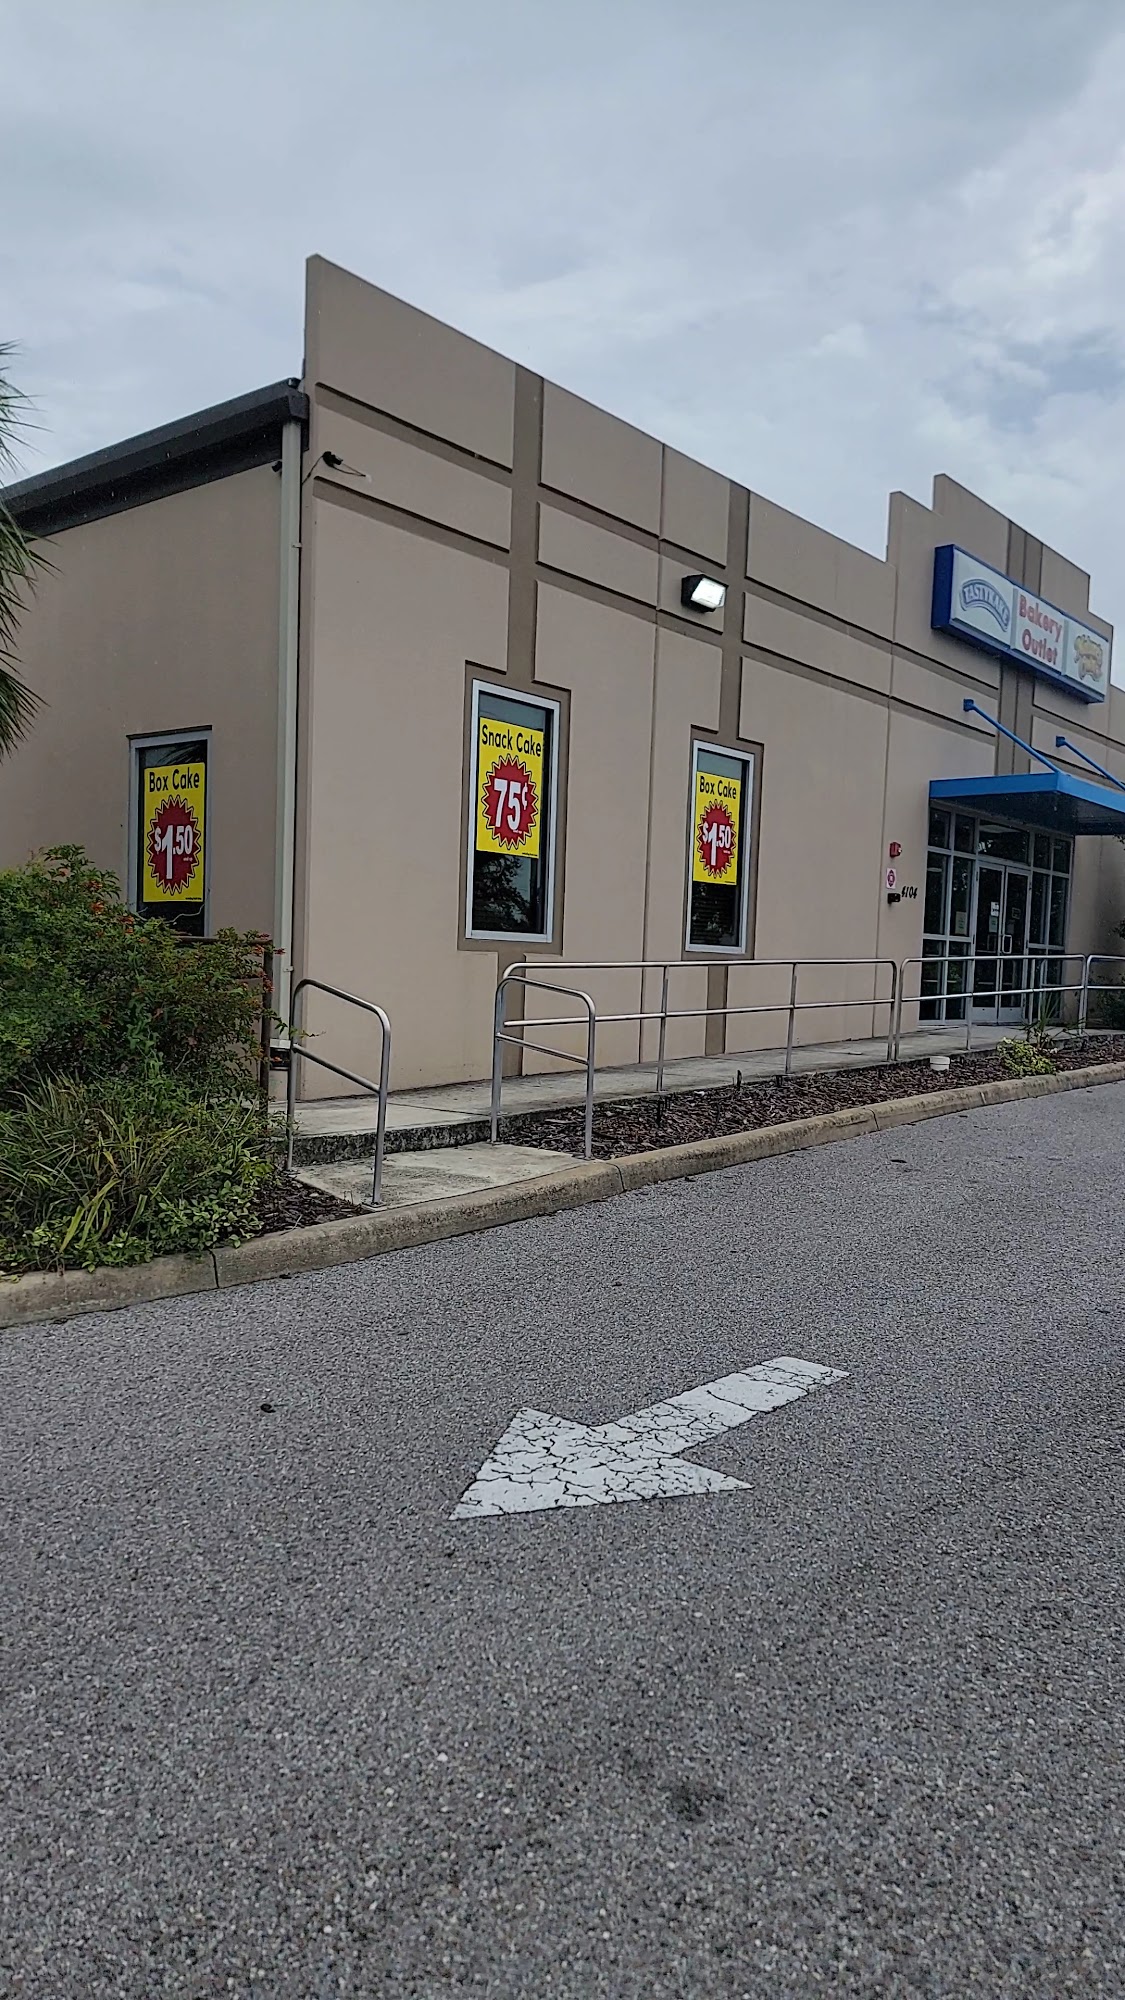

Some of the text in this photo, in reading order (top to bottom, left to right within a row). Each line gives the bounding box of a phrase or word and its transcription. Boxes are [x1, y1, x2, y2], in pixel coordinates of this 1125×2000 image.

[1019, 594, 1062, 642] Bakery
[1022, 629, 1057, 665] Outlet
[481, 724, 542, 757] Snack Cake
[149, 766, 200, 792] Box Cake
[699, 776, 737, 800] Box Cake
[154, 825, 193, 879] $1.50
[702, 821, 731, 866] $1.50
